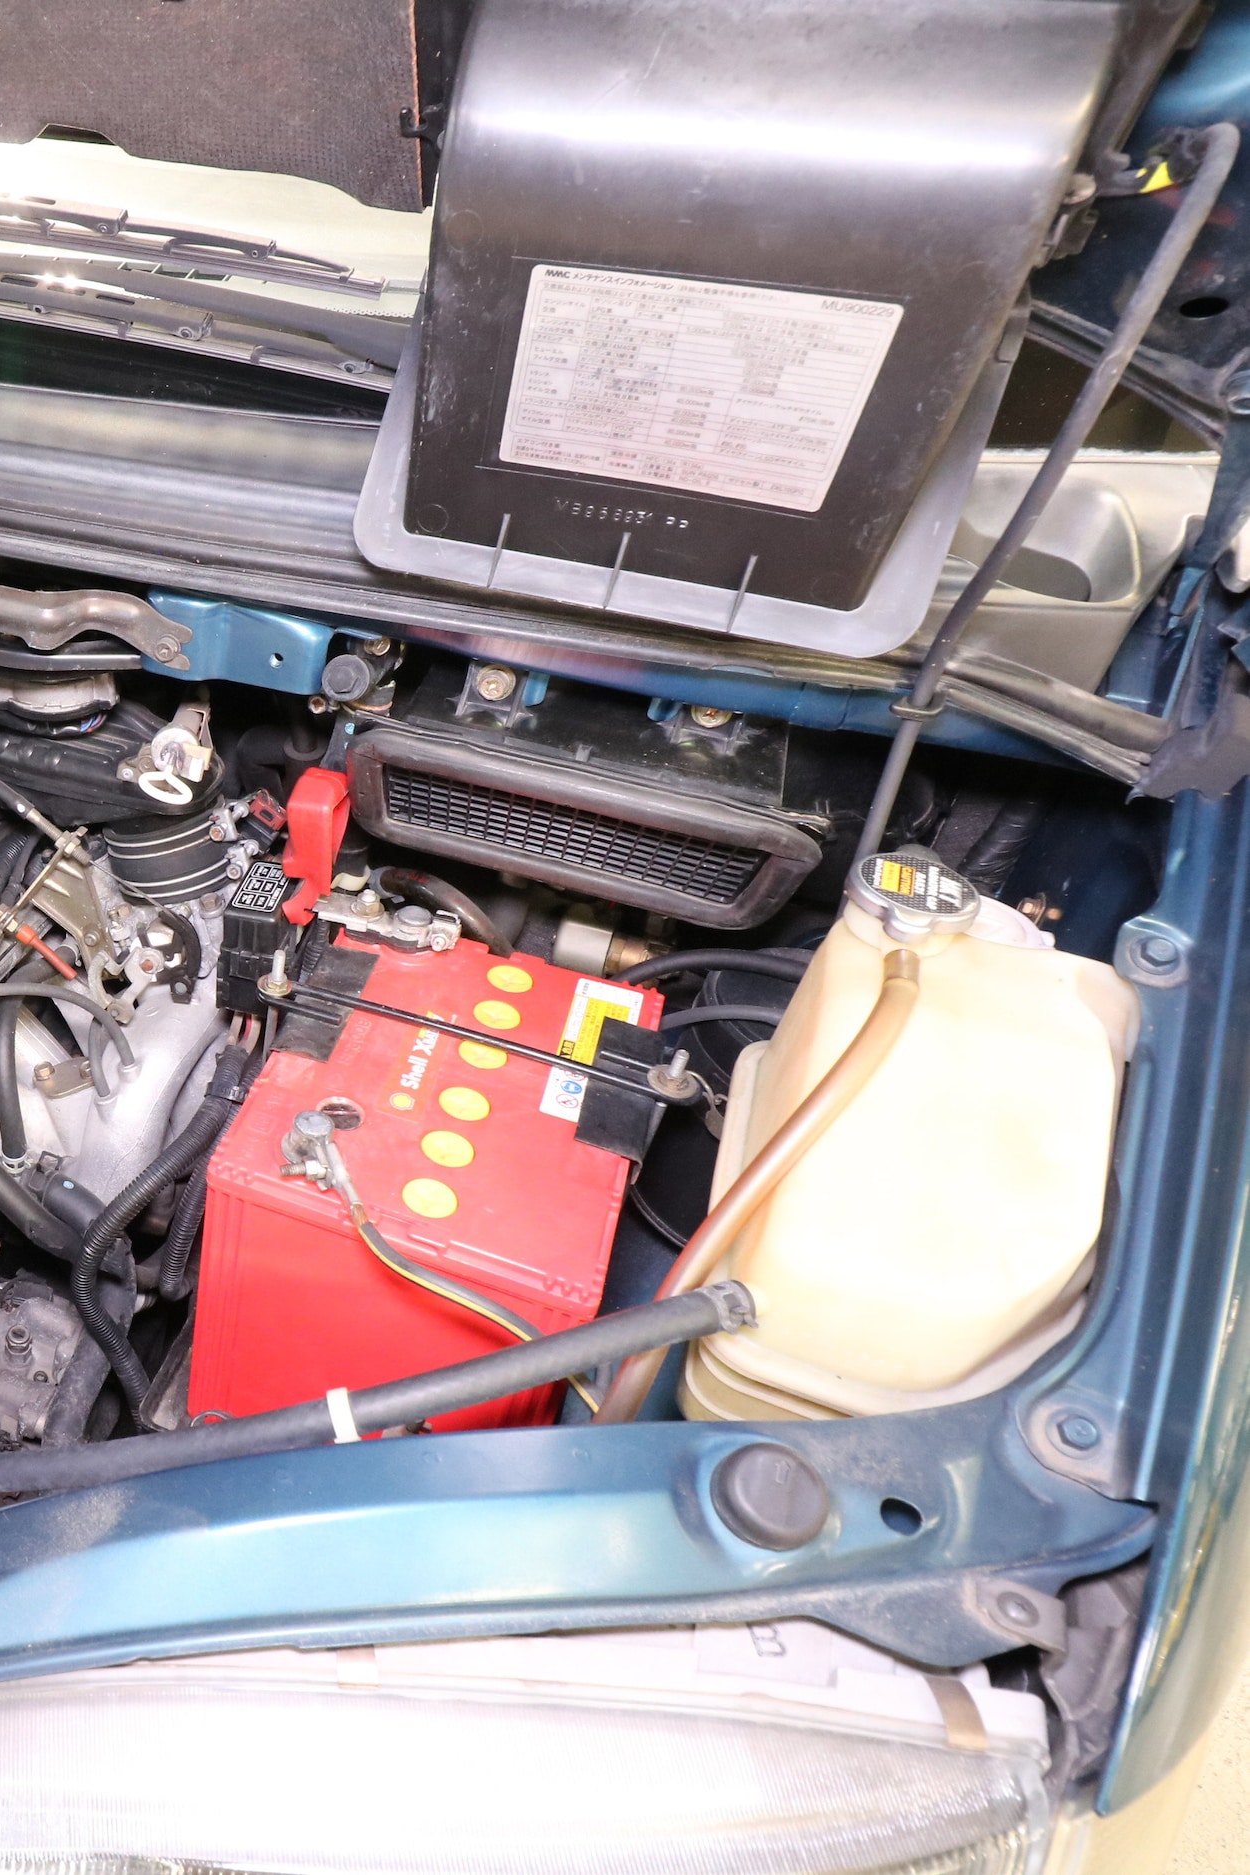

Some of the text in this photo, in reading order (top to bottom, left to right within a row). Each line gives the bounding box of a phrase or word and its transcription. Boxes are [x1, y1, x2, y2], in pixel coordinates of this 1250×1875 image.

[544, 269, 674, 291] MMC メンテナンスインフォメーション
[819, 300, 896, 318] MU900229
[899, 867, 914, 896] CAUTION
[399, 1054, 430, 1091] Shell
